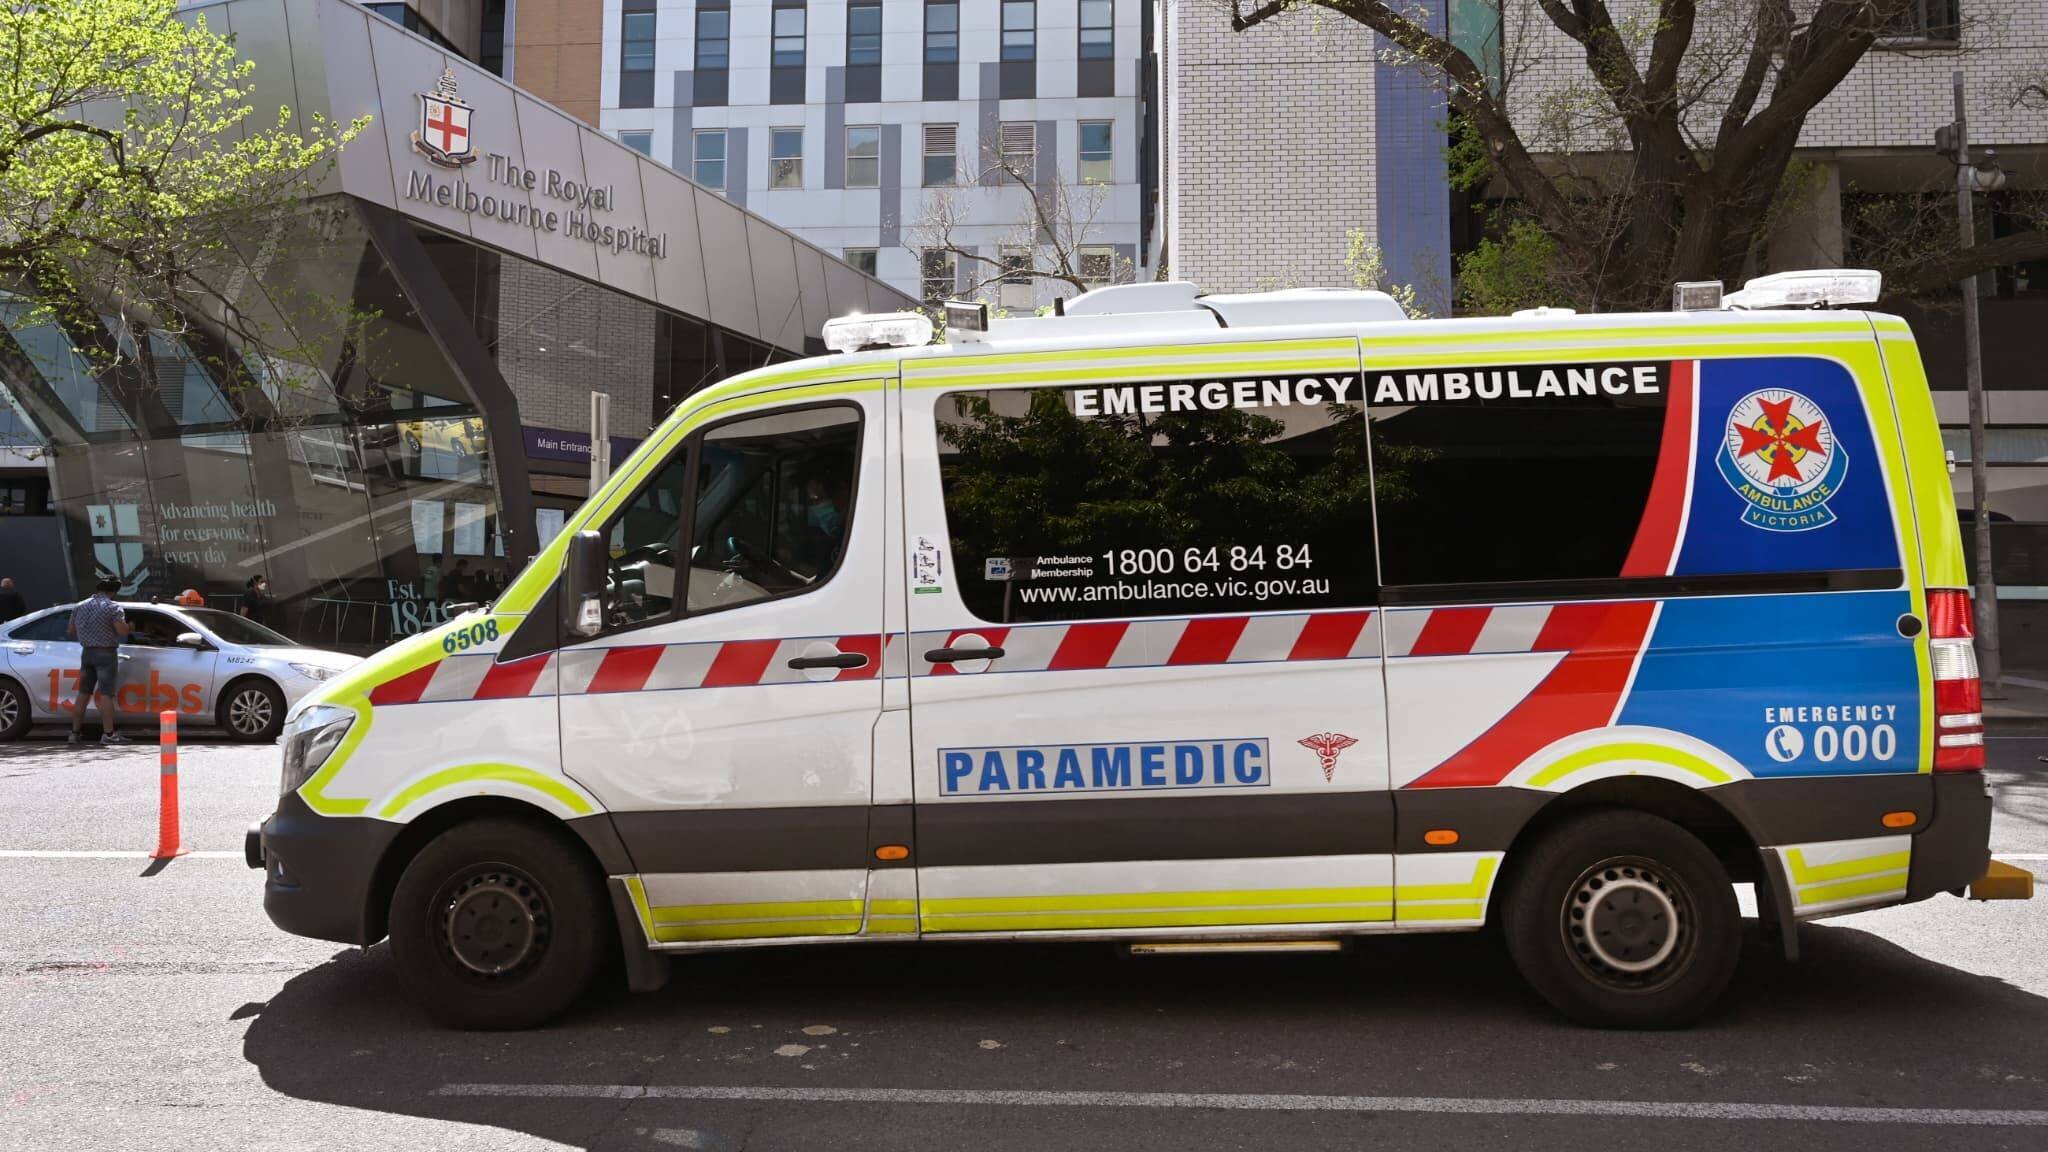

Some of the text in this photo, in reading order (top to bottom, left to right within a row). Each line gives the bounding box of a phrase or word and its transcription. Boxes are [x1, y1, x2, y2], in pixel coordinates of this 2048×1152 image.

[487, 152, 536, 191] The
[543, 167, 614, 212] Royal
[405, 169, 667, 259] Melbourne Hospital
[1074, 366, 1660, 416] EMERGENCY AMBULANCE
[537, 437, 592, 453] Main Entranc
[160, 499, 229, 520] Advancing
[231, 499, 277, 518] health
[1738, 483, 1832, 512] AMBULANCE
[1751, 510, 1825, 526] VICTORIA
[160, 524, 180, 542] for
[164, 551, 200, 568] every
[204, 546, 227, 568] day
[1036, 555, 1093, 565] Ambulance
[1102, 543, 1313, 576] 1800 64 84 84
[1031, 567, 1093, 579] Membership
[388, 579, 421, 599] Est.
[1019, 578, 1330, 603] www.ambulance.vic.gov.au
[443, 619, 499, 653] 6508
[48, 669, 204, 713] 13abs
[1765, 704, 1896, 723] EMERGENCY
[1814, 724, 1896, 762] 000
[945, 743, 1262, 792] PARAMEDIC
